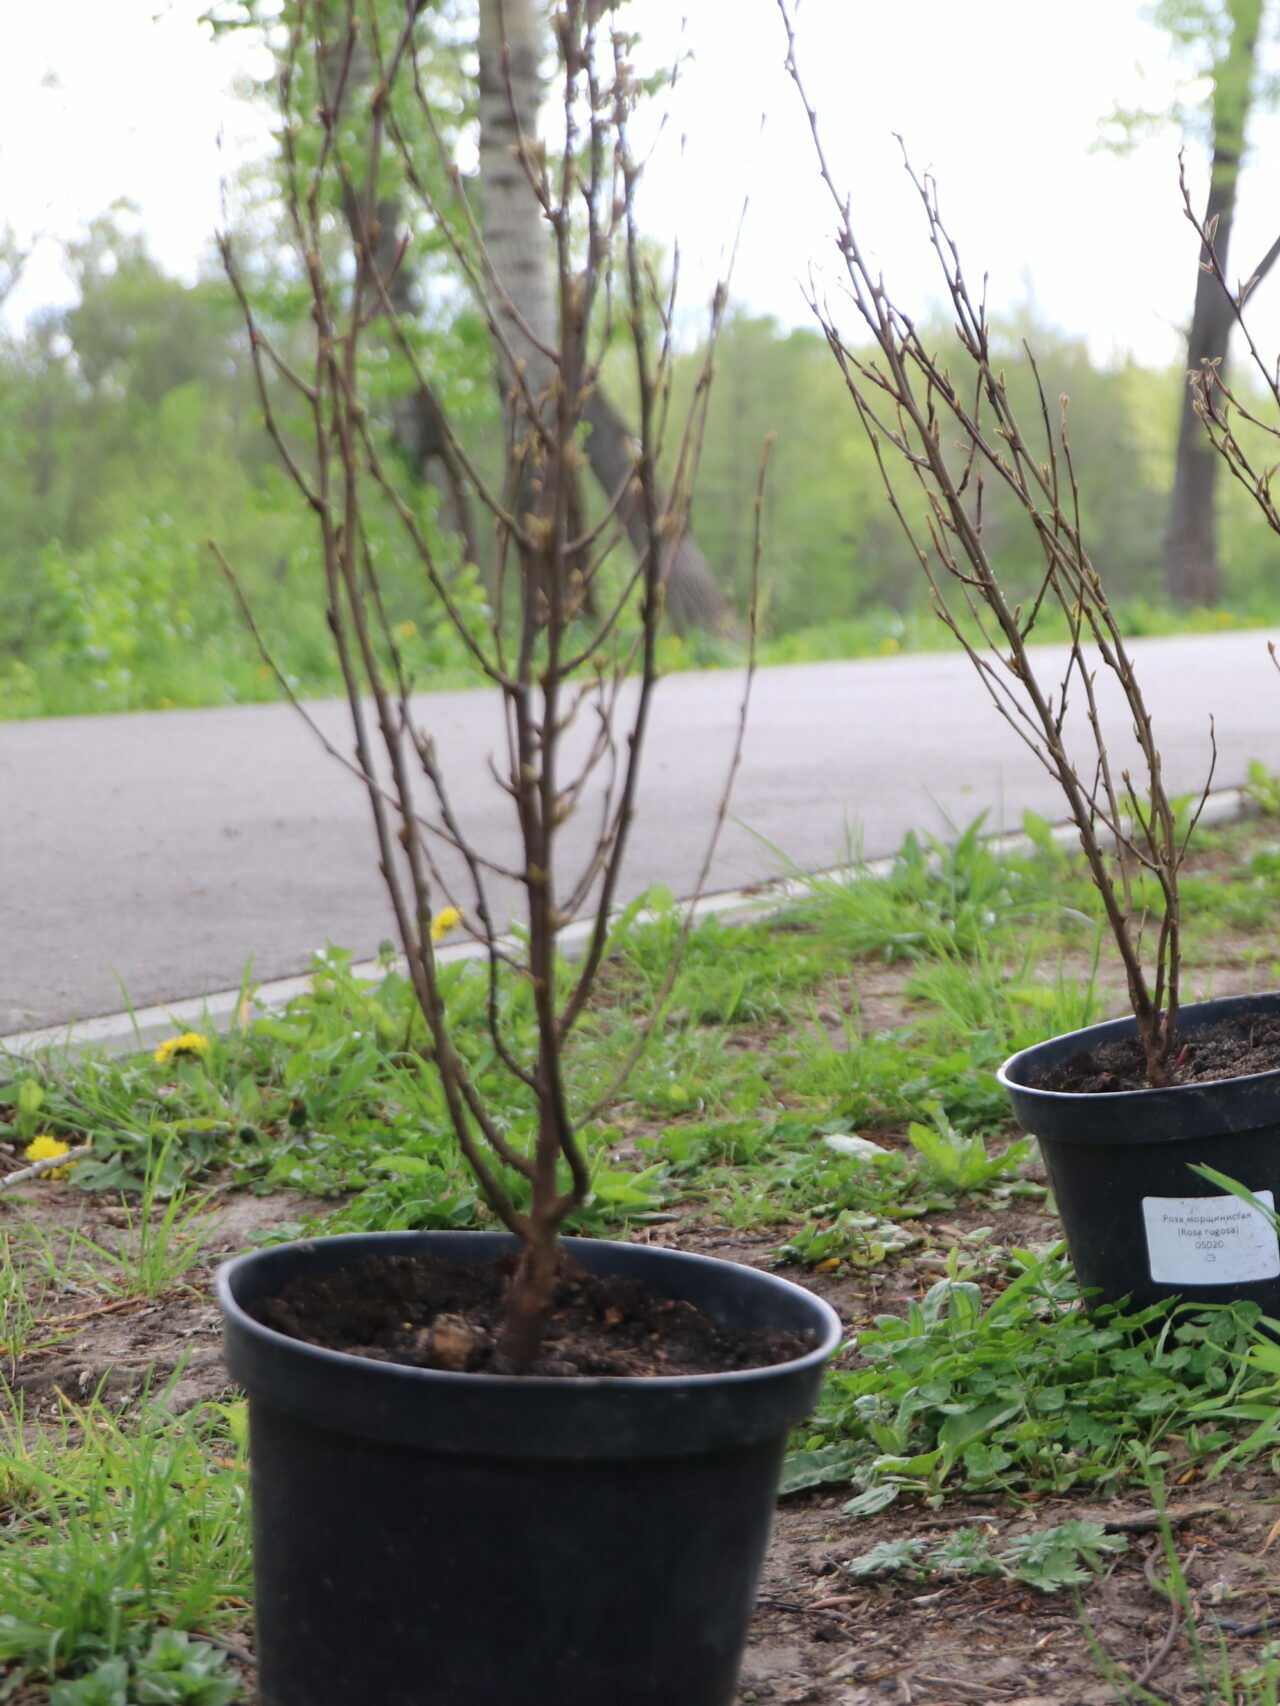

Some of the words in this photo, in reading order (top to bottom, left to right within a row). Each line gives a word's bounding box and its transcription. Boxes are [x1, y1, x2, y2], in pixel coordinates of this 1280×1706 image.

[1163, 1214, 1184, 1223] Роза
[1186, 1211, 1252, 1224] морщинистая
[1178, 1227, 1202, 1236] (Rosa
[1205, 1226, 1239, 1237] rugosa)
[1195, 1240, 1224, 1249] 05020
